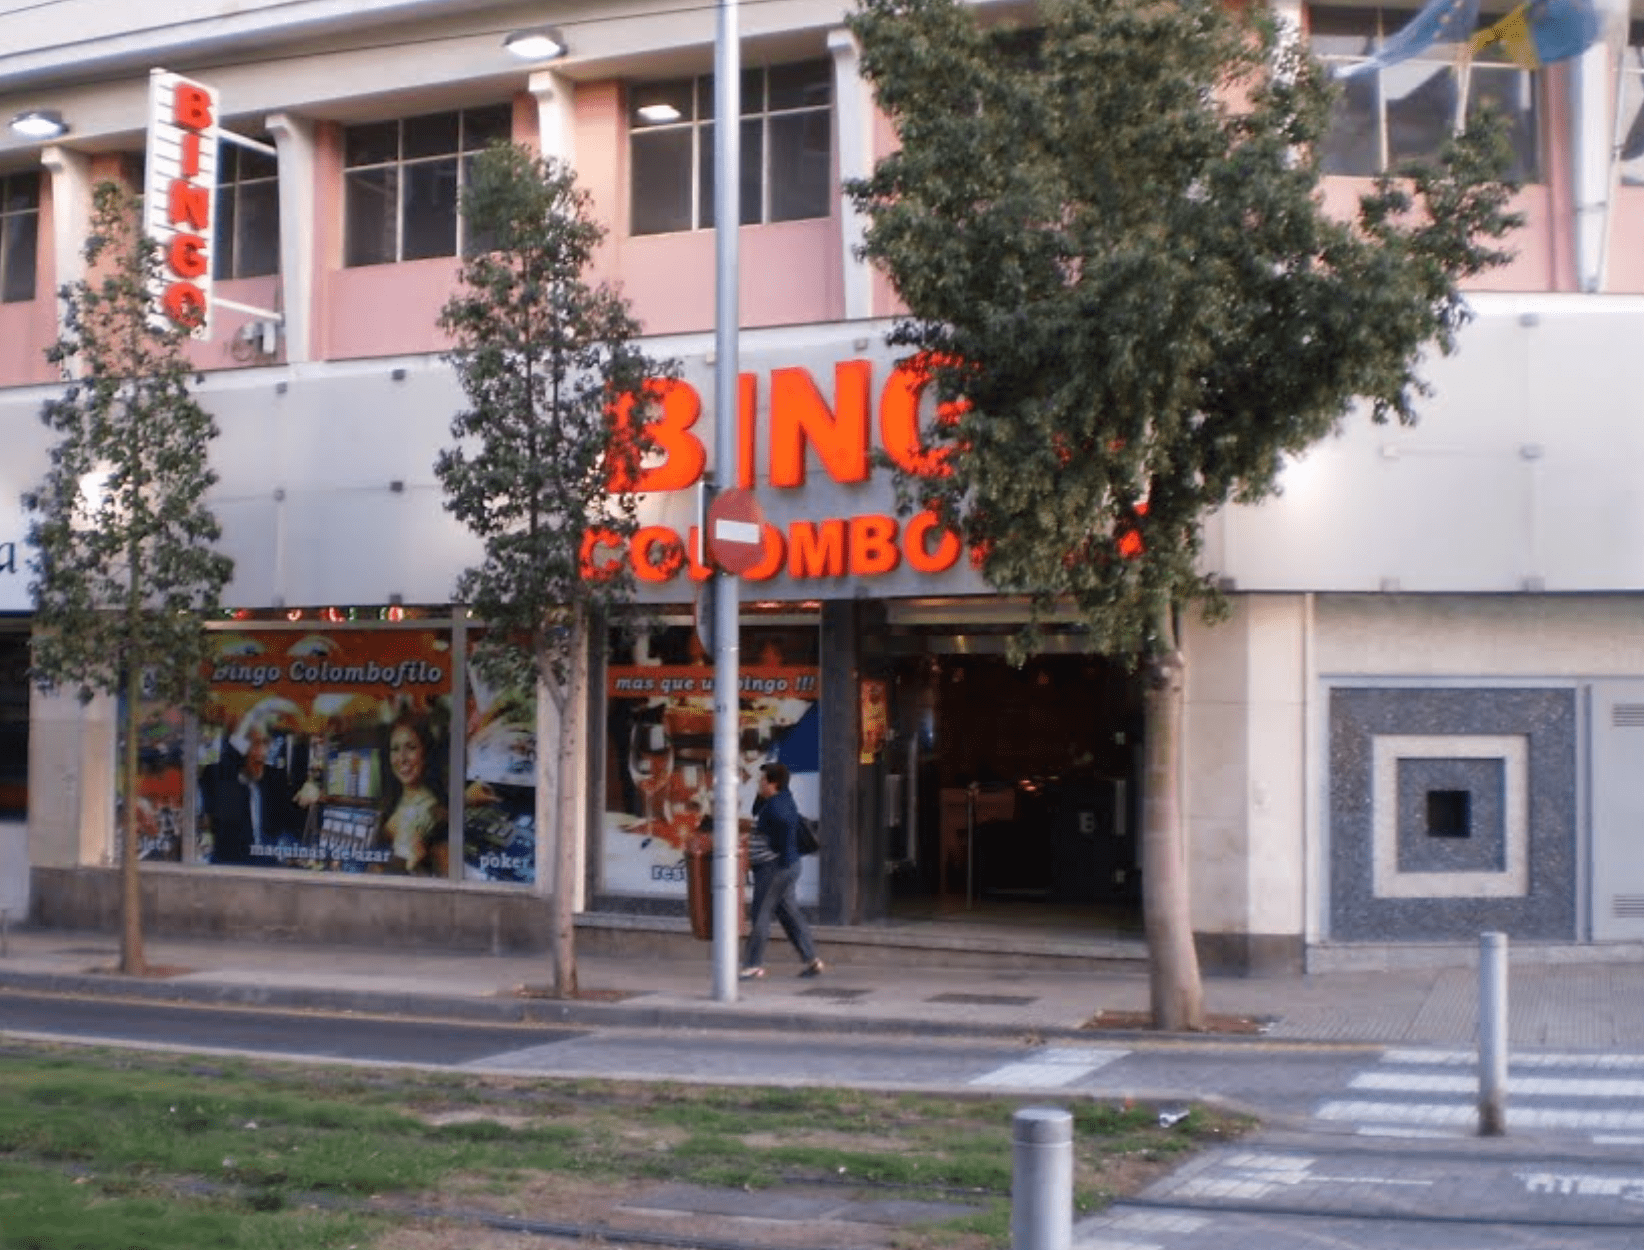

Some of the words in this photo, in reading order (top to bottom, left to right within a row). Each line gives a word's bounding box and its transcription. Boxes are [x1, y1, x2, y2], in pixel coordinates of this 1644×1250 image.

[161, 81, 214, 328] BINGO
[603, 356, 1080, 494] BING
[289, 660, 443, 688] Colombofilo
[616, 677, 654, 690] mas
[660, 677, 694, 692] que
[480, 852, 529, 873] poker
